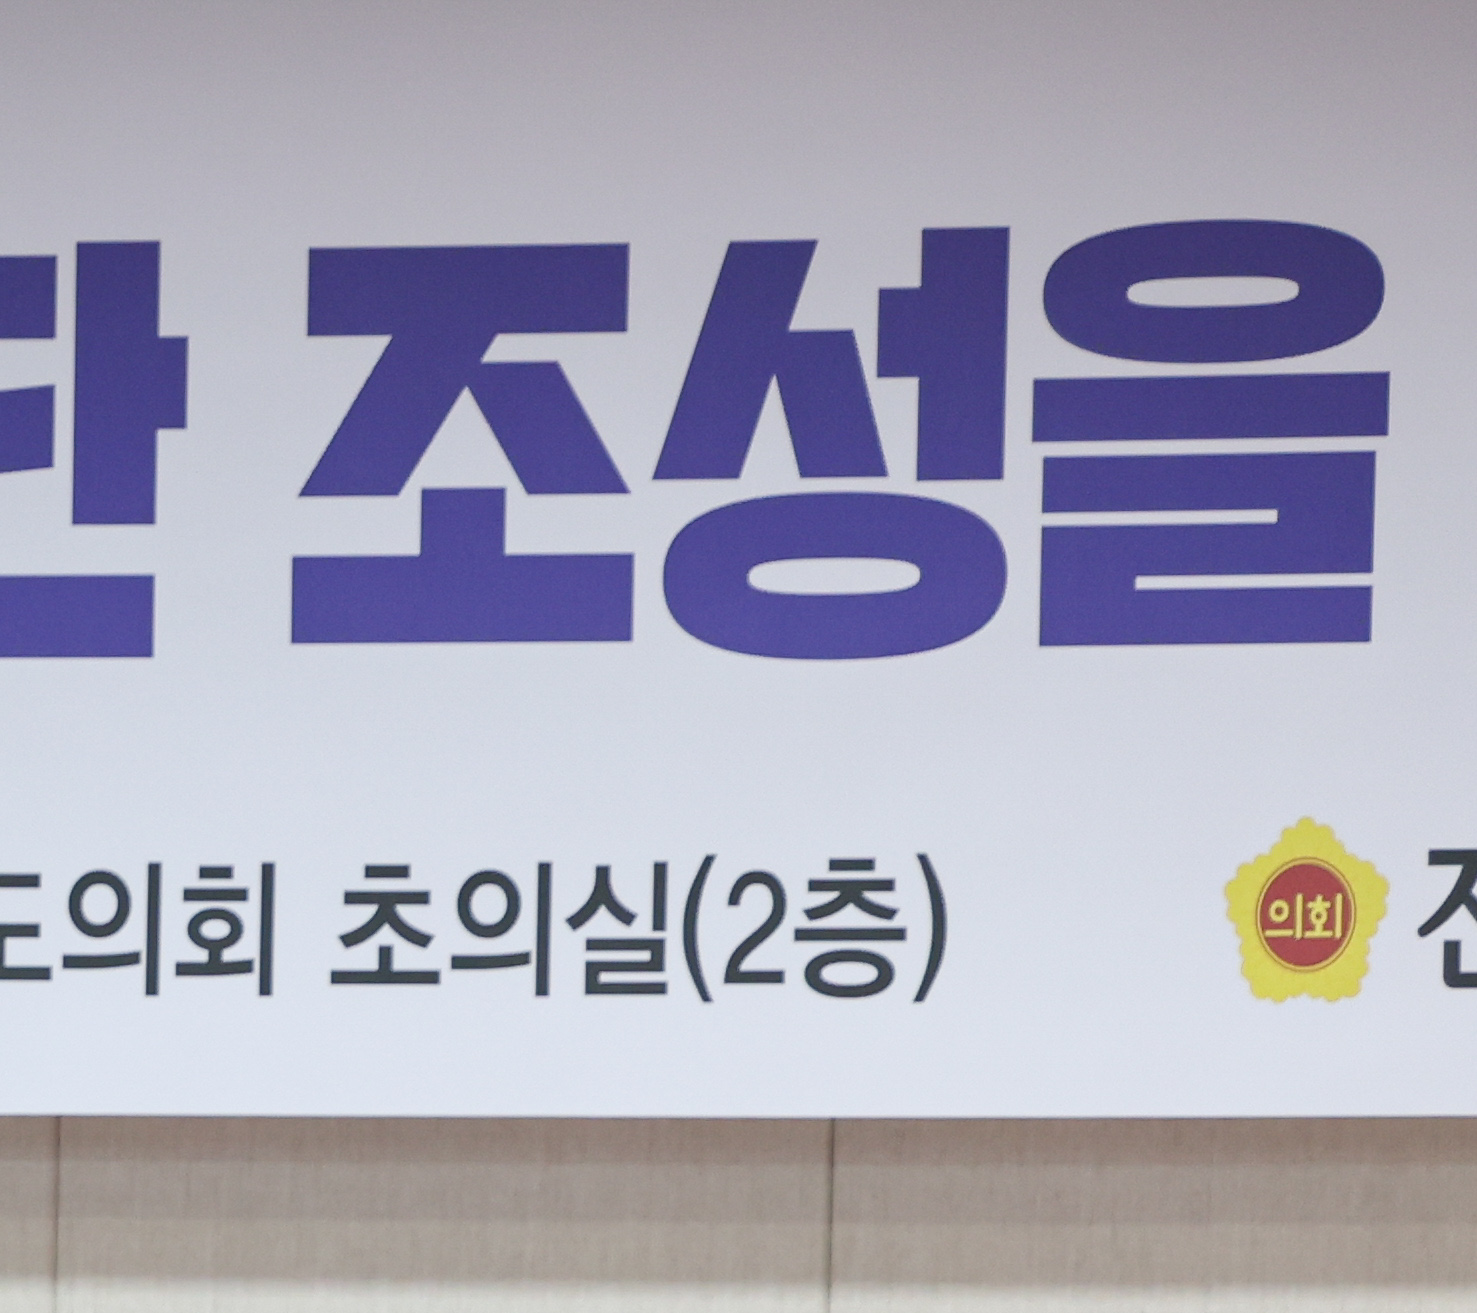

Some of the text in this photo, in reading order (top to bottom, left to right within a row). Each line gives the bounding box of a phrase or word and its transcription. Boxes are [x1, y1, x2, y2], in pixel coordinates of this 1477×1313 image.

[290, 218, 1392, 662] 조성을
[328, 852, 949, 1004] 초의실(2층)
[1263, 892, 1343, 941] 의회
